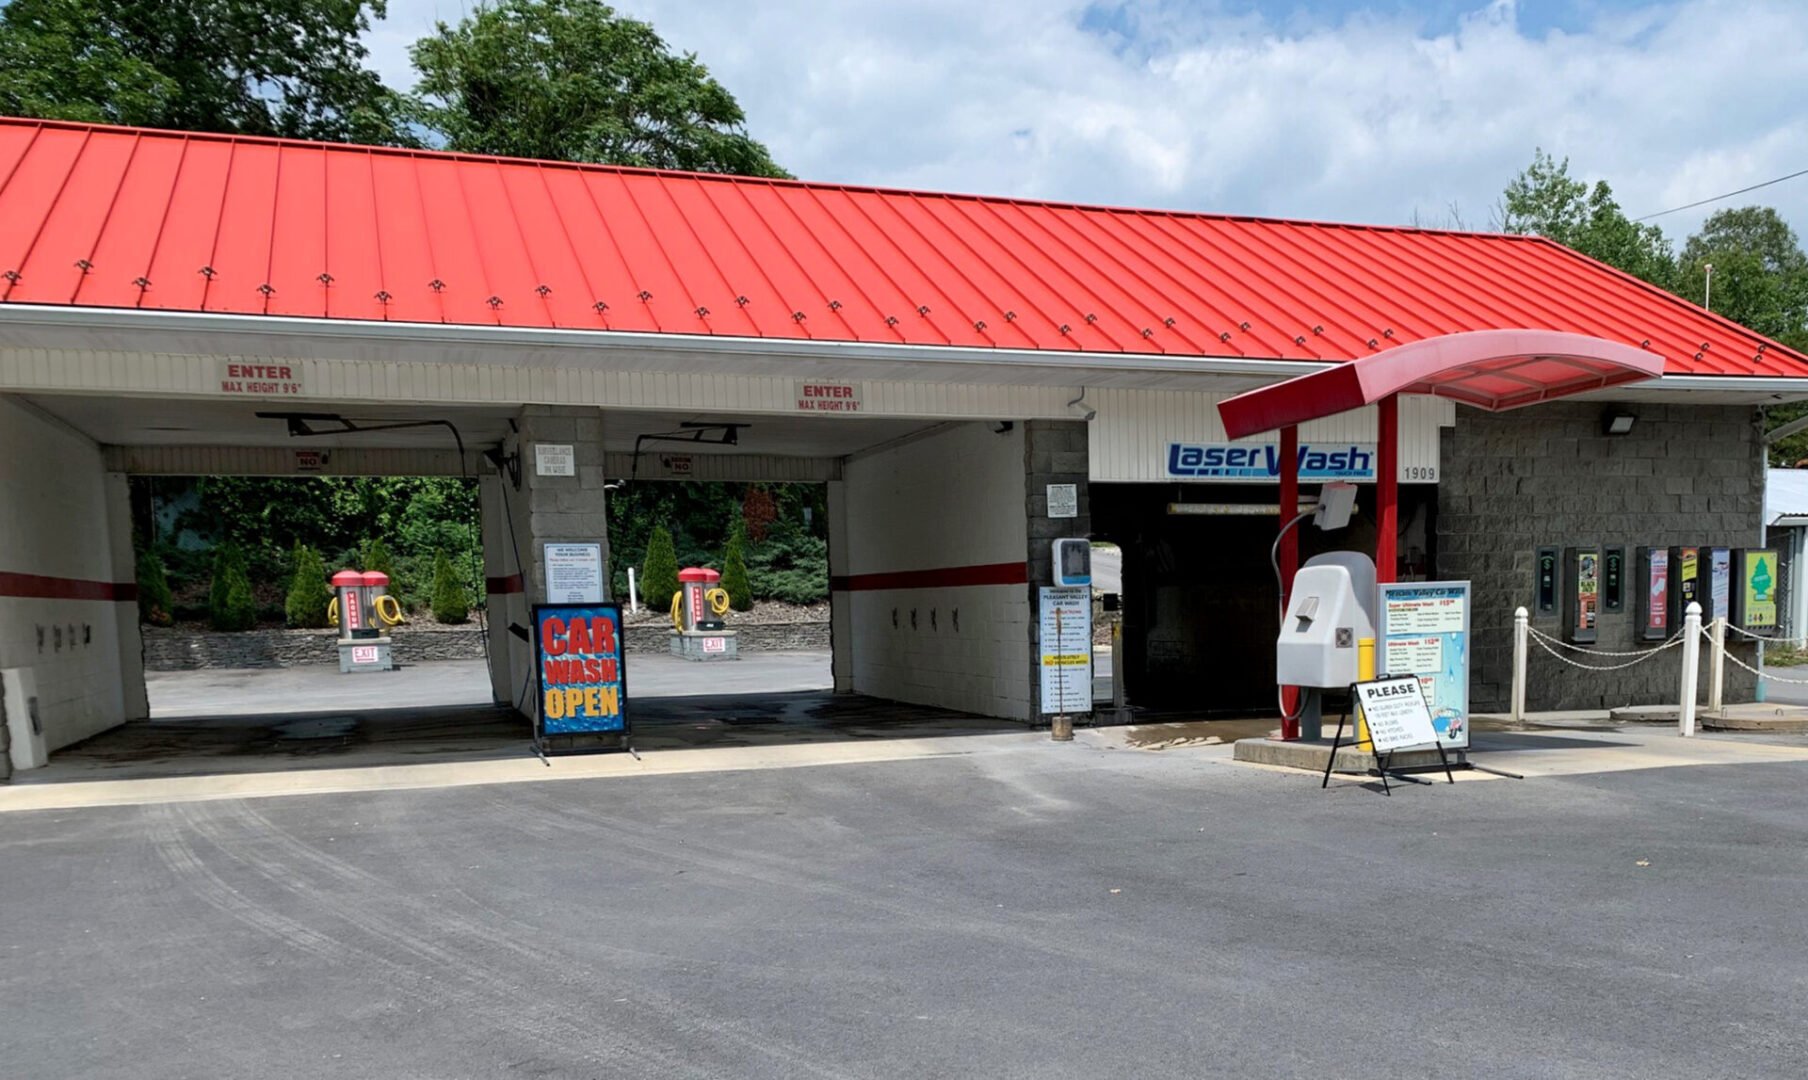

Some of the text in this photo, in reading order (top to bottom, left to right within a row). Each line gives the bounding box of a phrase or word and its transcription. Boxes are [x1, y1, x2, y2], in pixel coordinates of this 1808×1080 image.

[228, 364, 292, 379] ENTER
[222, 381, 243, 393] MAX
[246, 382, 279, 393] HEIGHT
[803, 385, 853, 398] ENTER
[799, 400, 815, 410] MAX
[818, 400, 842, 411] HEIGHT
[1405, 467, 1435, 480] 1909
[1414, 588, 1434, 598] Valley
[349, 592, 359, 628] VACUUM
[542, 616, 615, 656] CAR
[704, 638, 722, 649] EXIT
[354, 648, 375, 658] EXIT
[544, 659, 618, 684] WASH
[1367, 683, 1416, 698] PLEASE
[545, 687, 619, 719] OPEN
